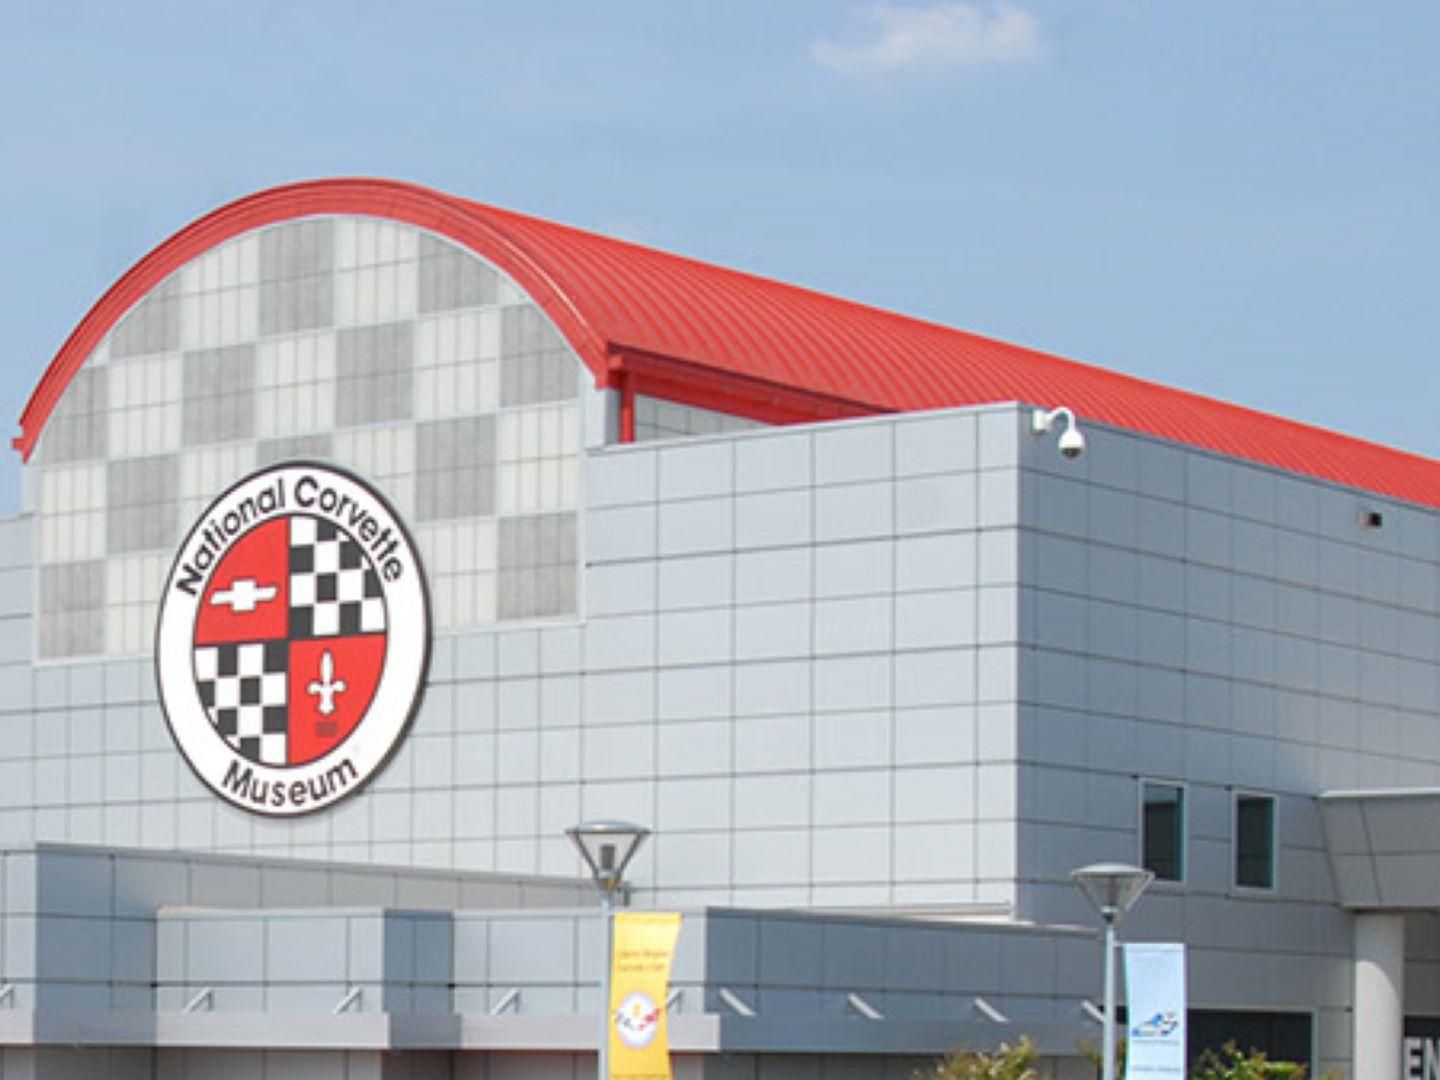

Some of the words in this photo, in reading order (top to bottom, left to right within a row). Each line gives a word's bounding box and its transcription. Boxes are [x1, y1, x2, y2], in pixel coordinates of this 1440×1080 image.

[175, 477, 285, 597] National
[293, 475, 403, 583] Corvette
[222, 758, 359, 807] Museum
